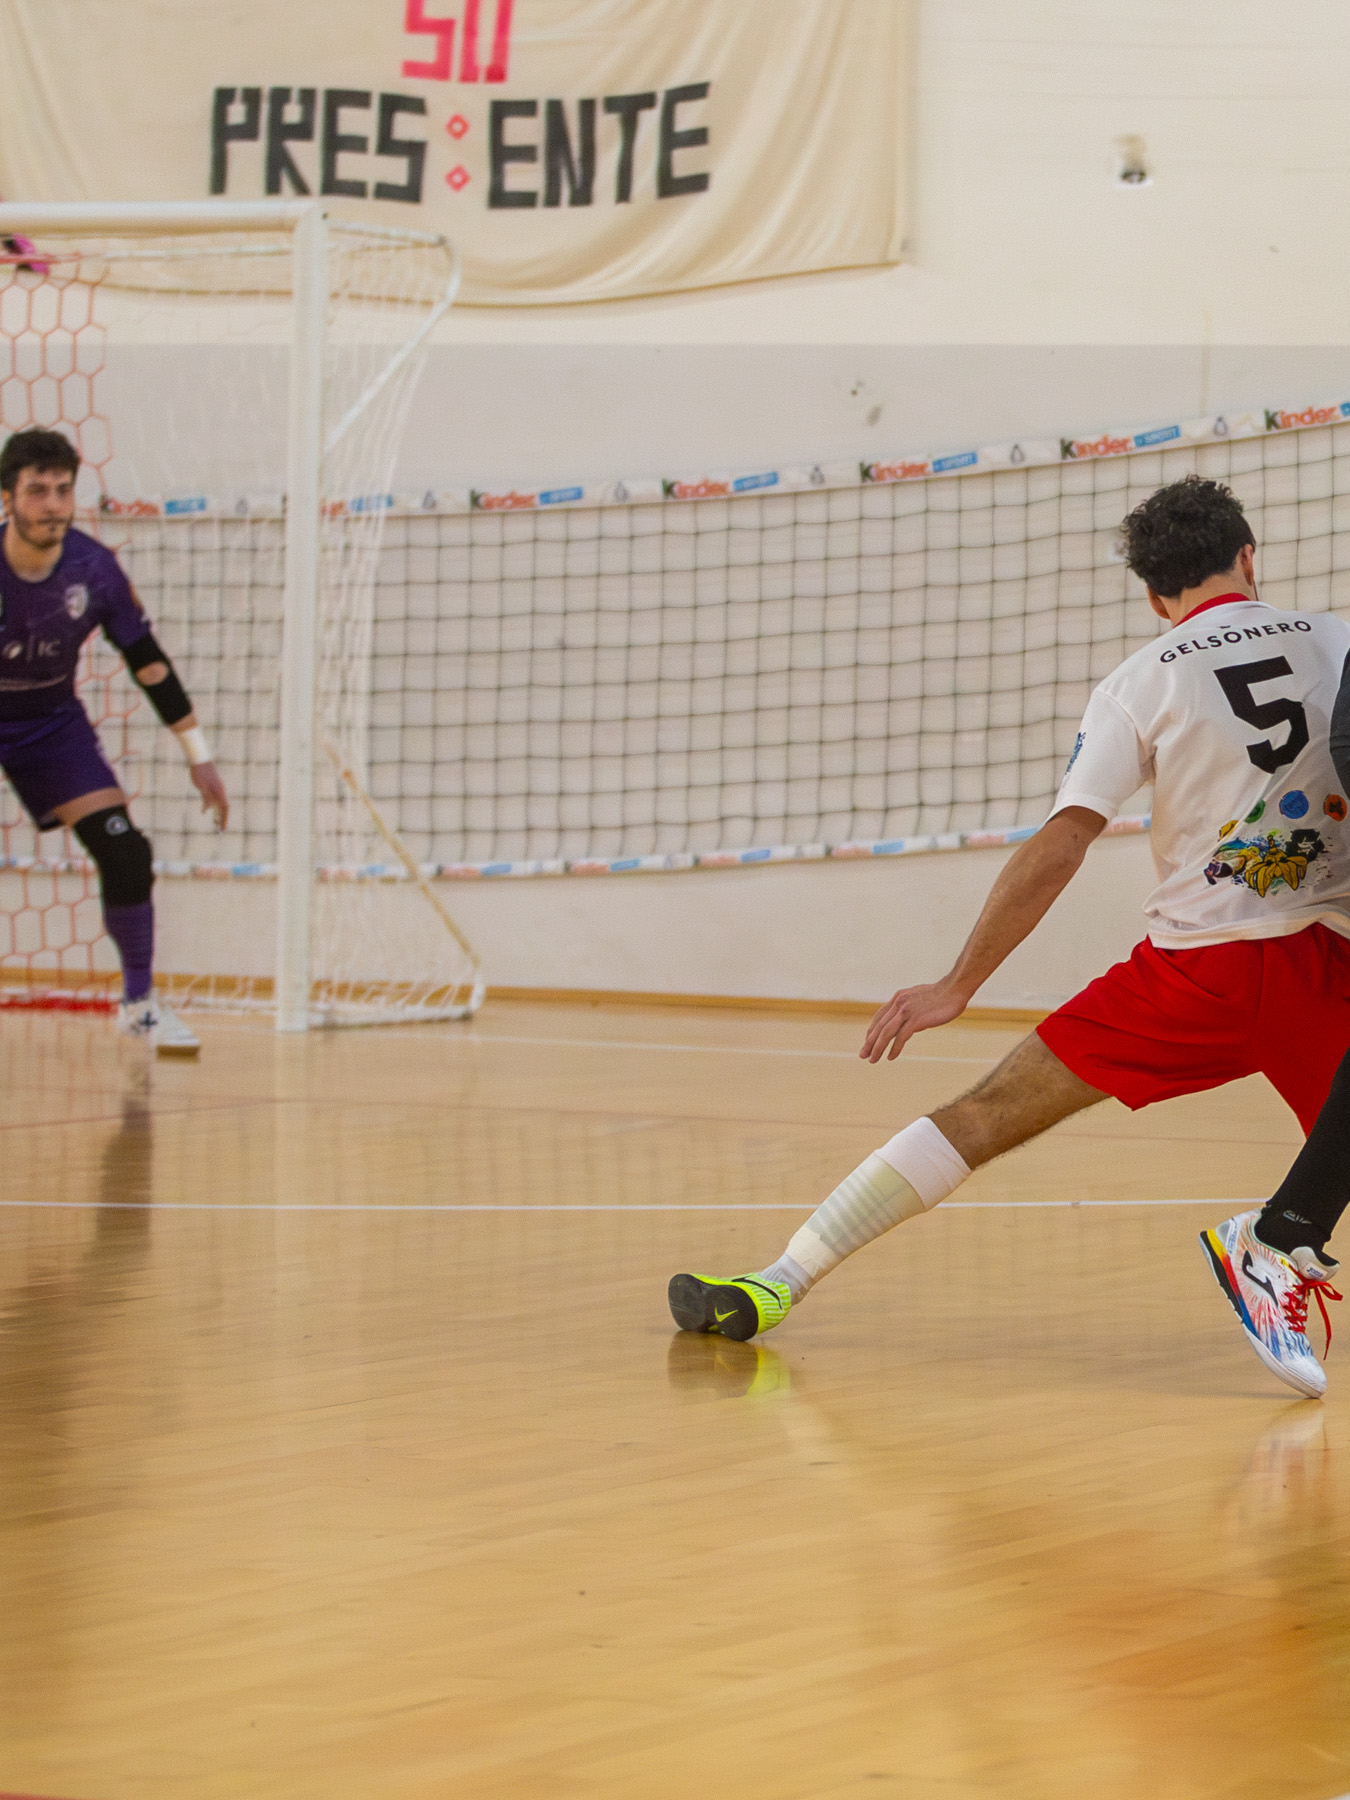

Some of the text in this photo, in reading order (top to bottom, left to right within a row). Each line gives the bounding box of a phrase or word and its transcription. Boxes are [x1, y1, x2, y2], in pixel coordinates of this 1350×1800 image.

[1263, 406, 1337, 432] Kinder
[1159, 620, 1312, 664] GELSONERO
[1213, 655, 1310, 774] 5
